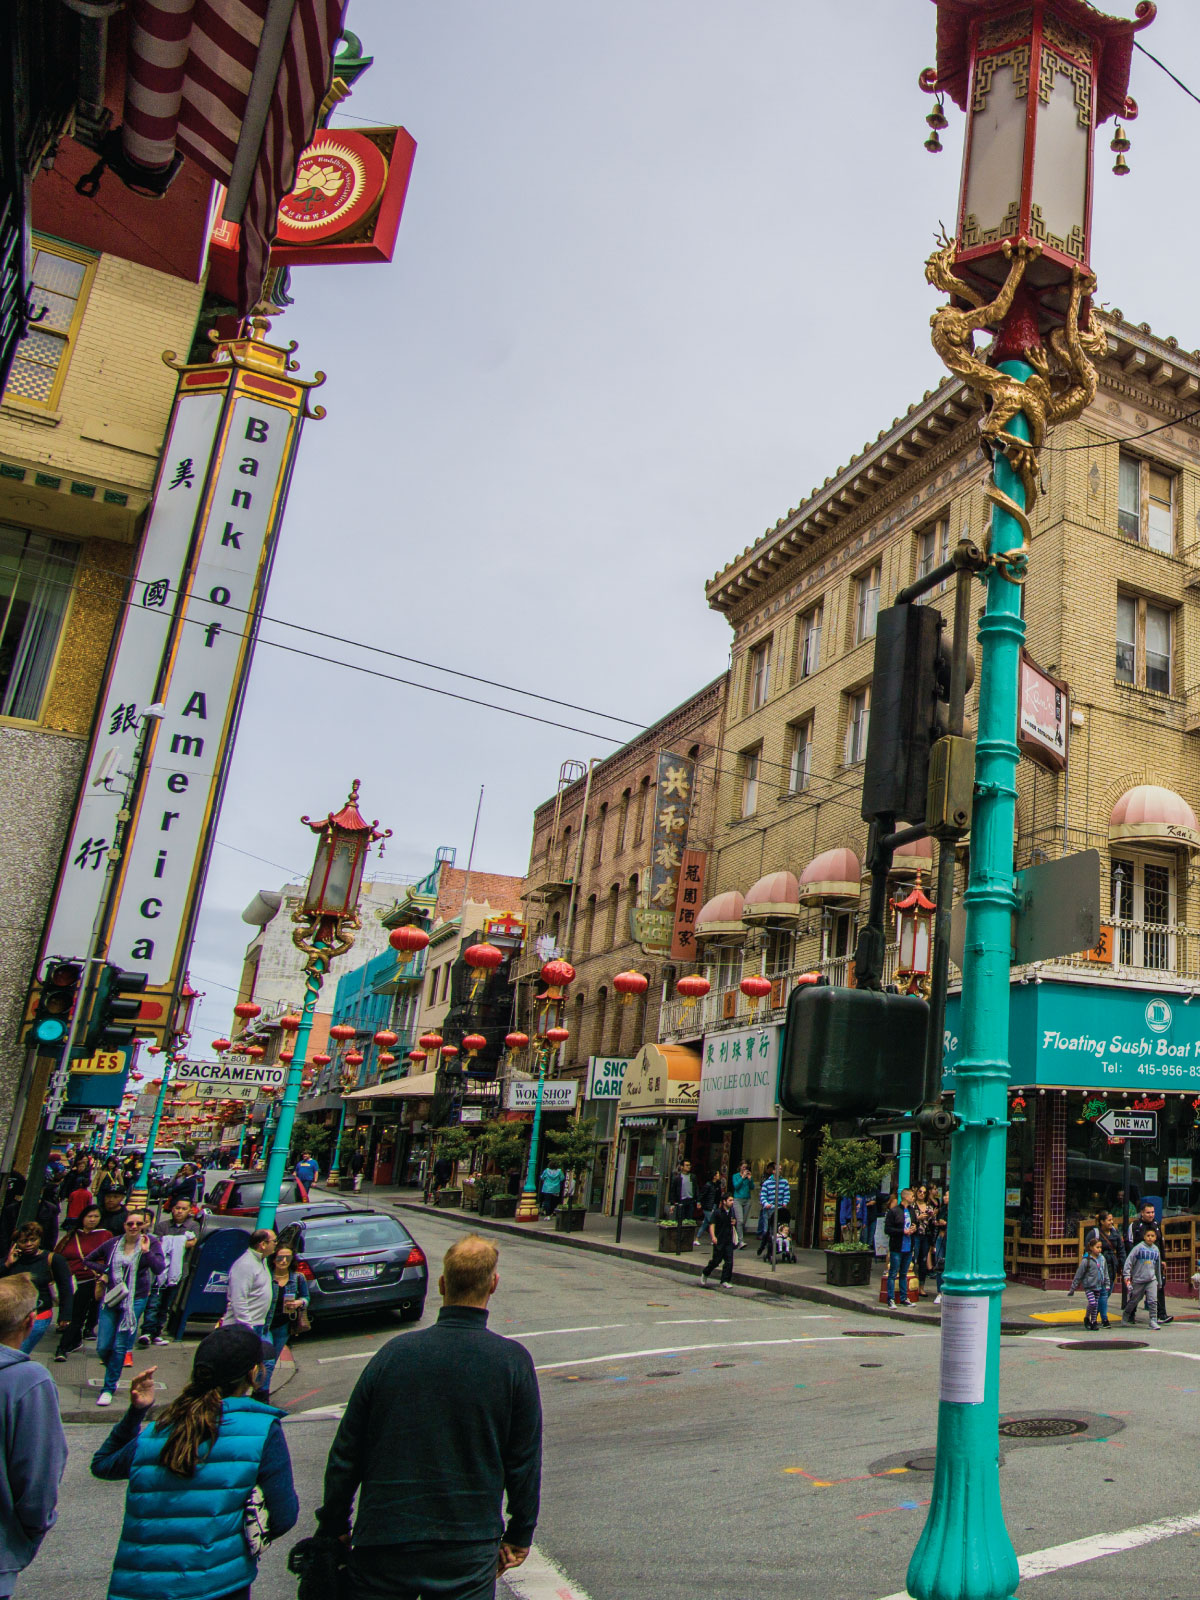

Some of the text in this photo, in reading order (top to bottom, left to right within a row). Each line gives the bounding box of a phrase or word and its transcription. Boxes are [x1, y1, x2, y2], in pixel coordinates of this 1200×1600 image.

[74, 458, 195, 871] 美國銀行
[130, 417, 270, 961] Bank of America
[1167, 825, 1193, 840] Kan's
[706, 1035, 770, 1067] 東利珠寶行
[1042, 1030, 1106, 1058] Floating
[1109, 1035, 1153, 1058] Sushi
[1155, 1038, 1190, 1058] Boat
[230, 1055, 247, 1063] 800
[1101, 1061, 1123, 1073] Tel:
[179, 1064, 283, 1082] SACRAMENTO
[702, 1070, 770, 1092] TUNG LEE CO. INC.
[543, 1089, 571, 1099] SHOP
[1114, 1118, 1150, 1129] ONE WAY
